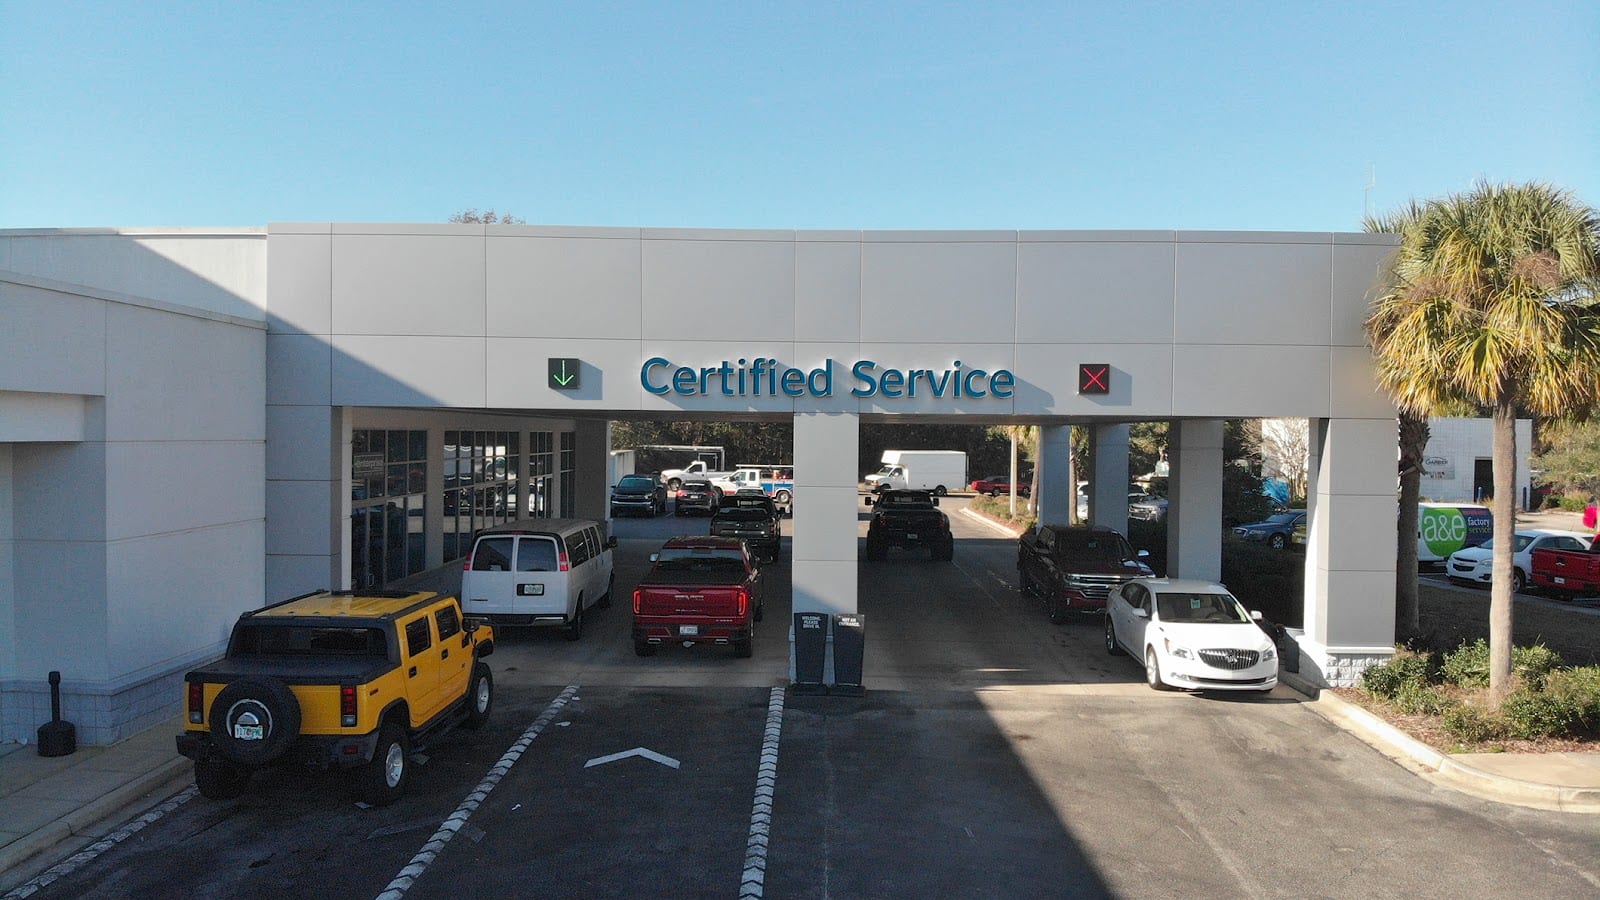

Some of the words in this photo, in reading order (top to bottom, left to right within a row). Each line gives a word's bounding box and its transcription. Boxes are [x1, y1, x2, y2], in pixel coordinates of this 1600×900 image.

[640, 356, 833, 397] Certified
[850, 360, 1015, 398] Service
[1423, 515, 1465, 542] a&e
[1467, 517, 1490, 527] factory
